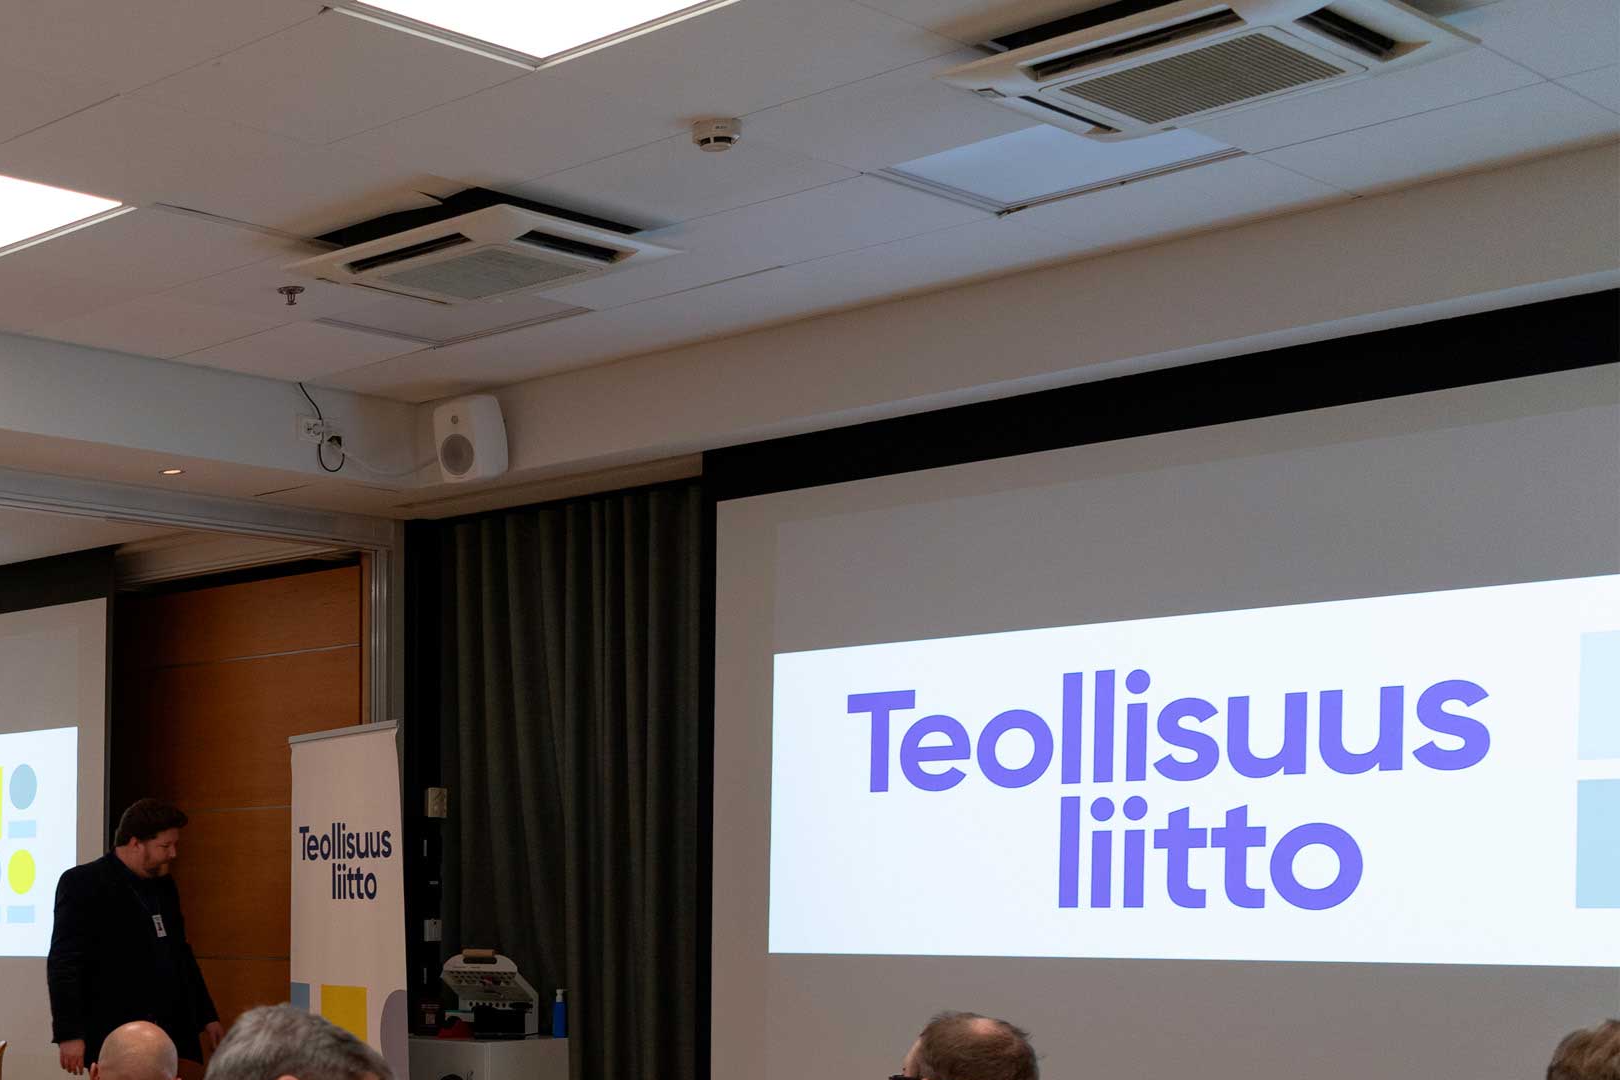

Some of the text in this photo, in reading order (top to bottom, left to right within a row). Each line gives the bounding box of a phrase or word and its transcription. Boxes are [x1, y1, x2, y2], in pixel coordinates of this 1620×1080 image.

[846, 668, 1491, 794] Teollisuus
[298, 822, 393, 861] Teollisuus
[1058, 795, 1364, 911] liitto
[331, 862, 378, 901] liitto
